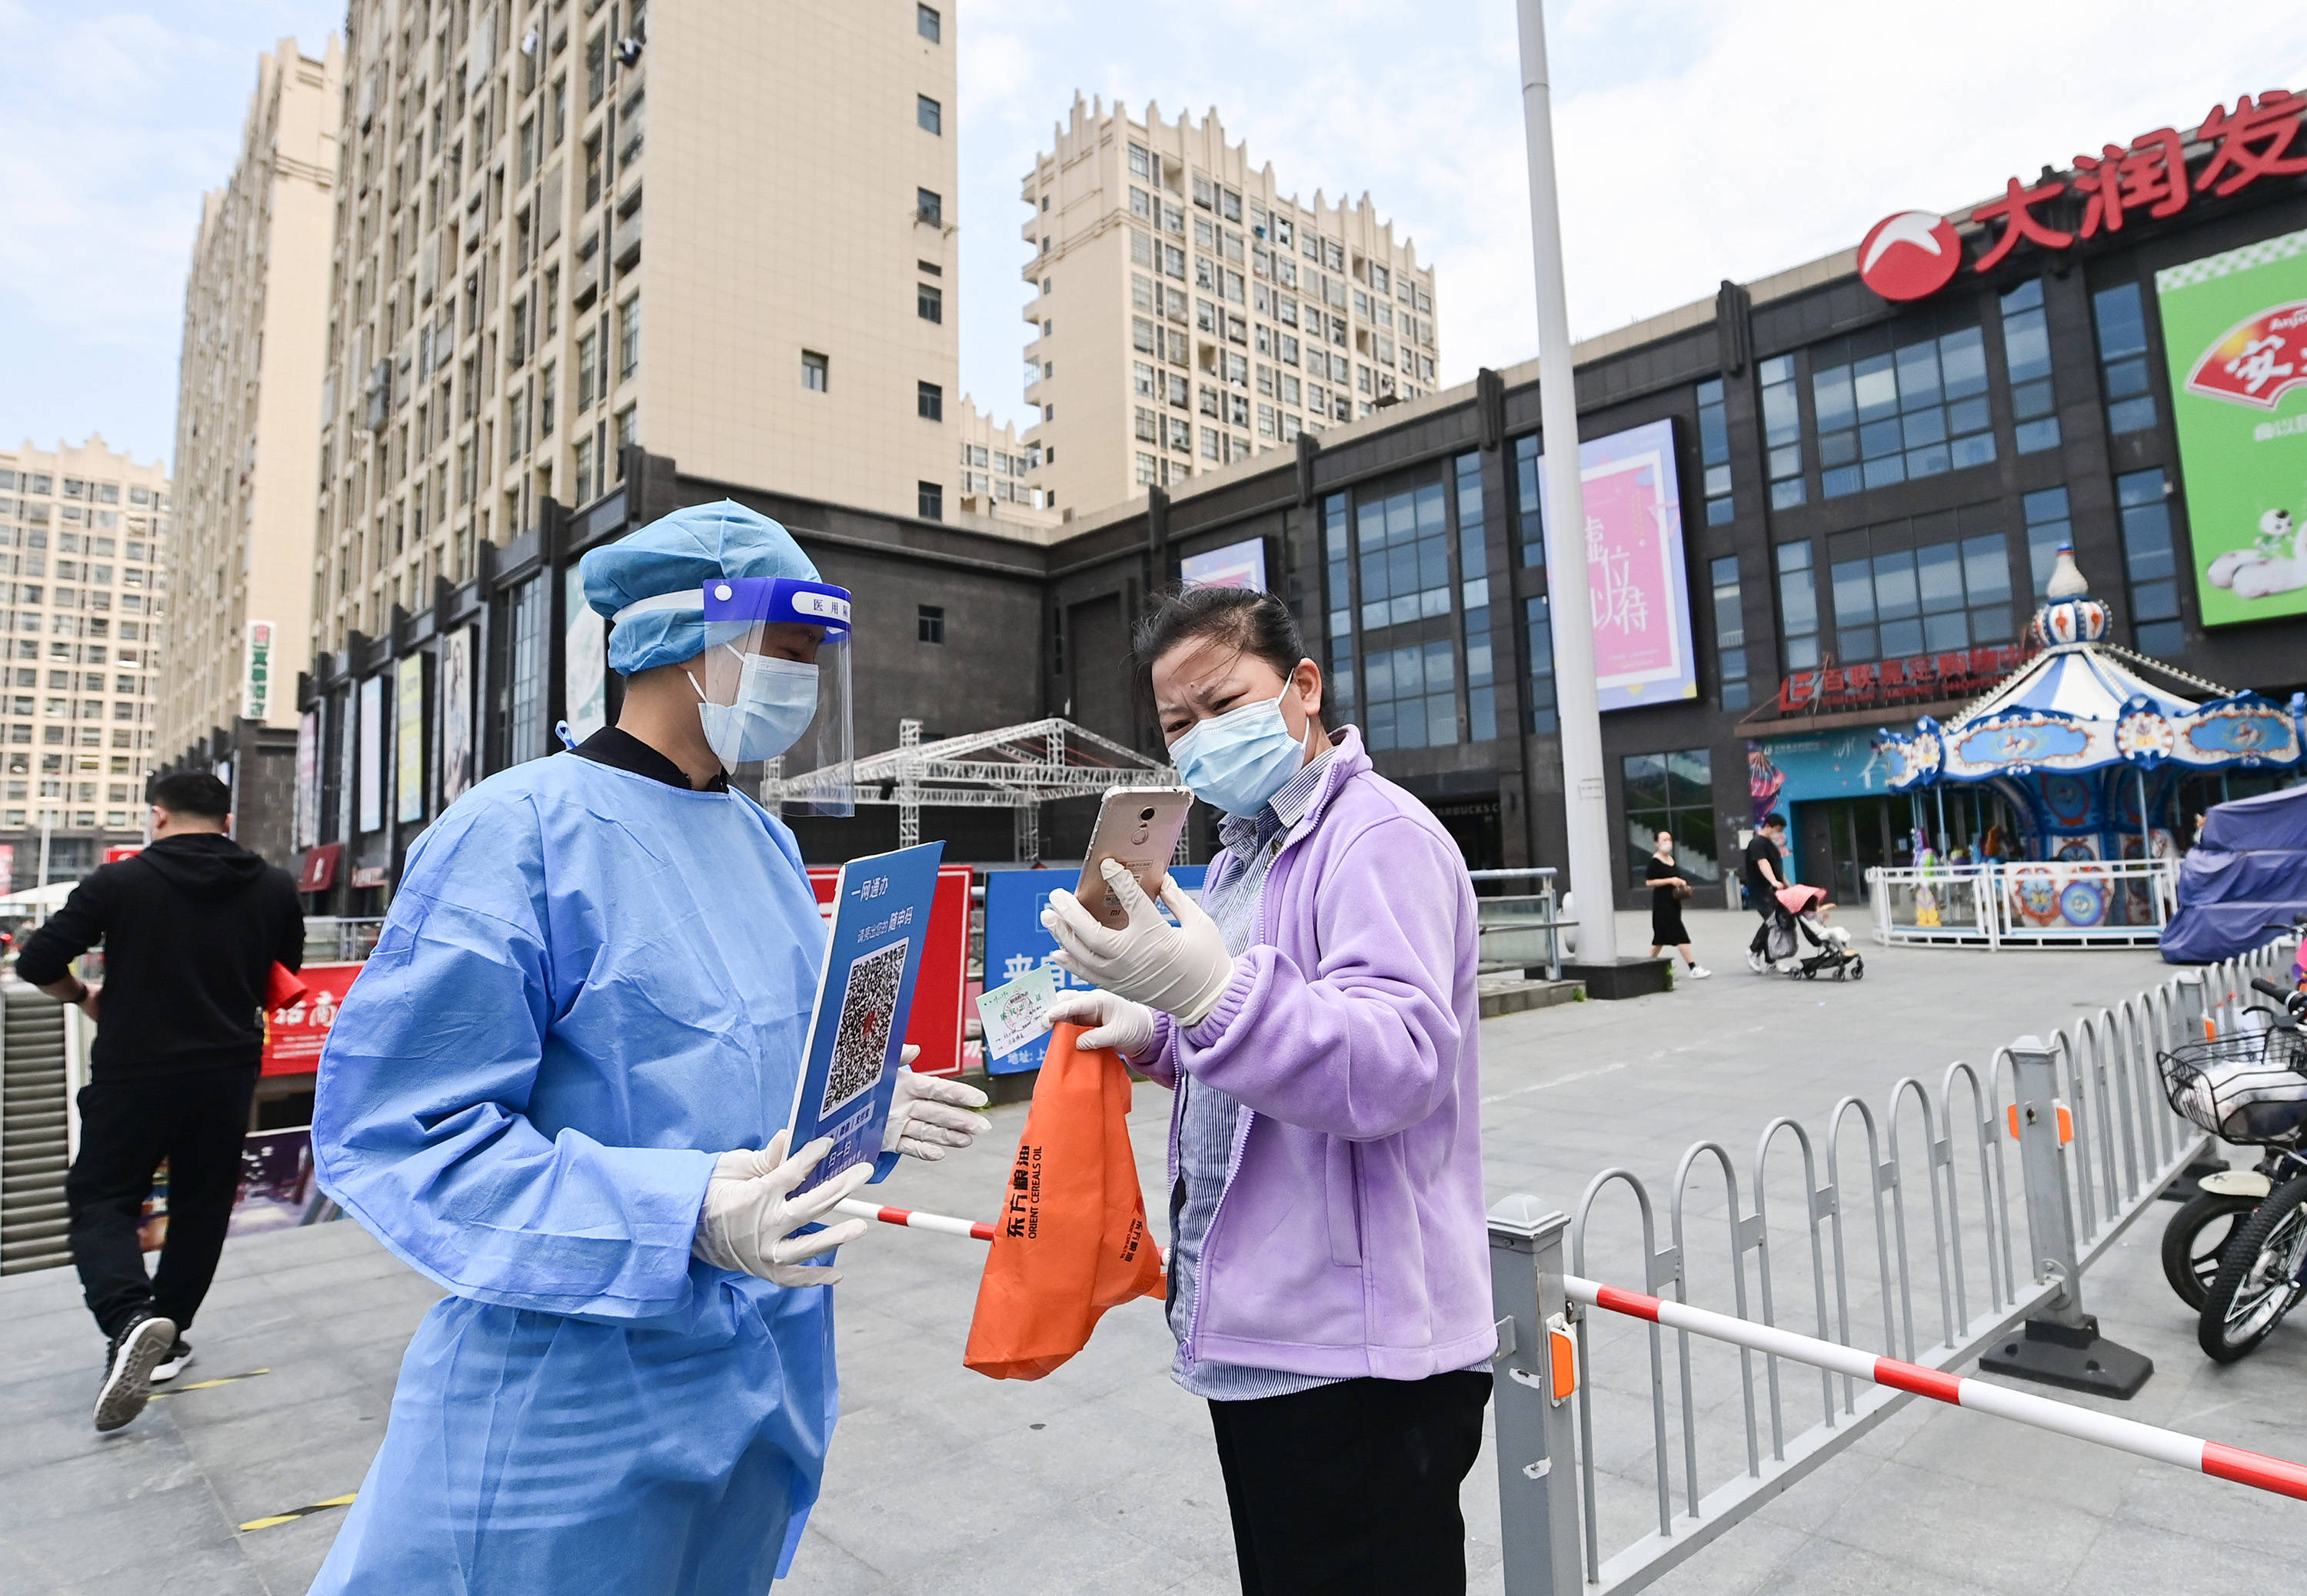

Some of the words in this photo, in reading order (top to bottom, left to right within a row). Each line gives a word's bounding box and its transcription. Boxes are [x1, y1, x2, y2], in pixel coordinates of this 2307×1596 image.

[1971, 90, 2307, 272] 大润发
[2225, 334, 2307, 394] 安
[851, 875, 888, 901] 一网通办
[1004, 953, 1089, 988] 来自
[1034, 1145, 1042, 1160] OIL
[1007, 1145, 1030, 1238] 东方粮油
[1031, 1163, 1041, 1204] CEREALS
[1028, 1206, 1038, 1239] ORIENT
[1124, 1220, 1144, 1262] 东方粮油
